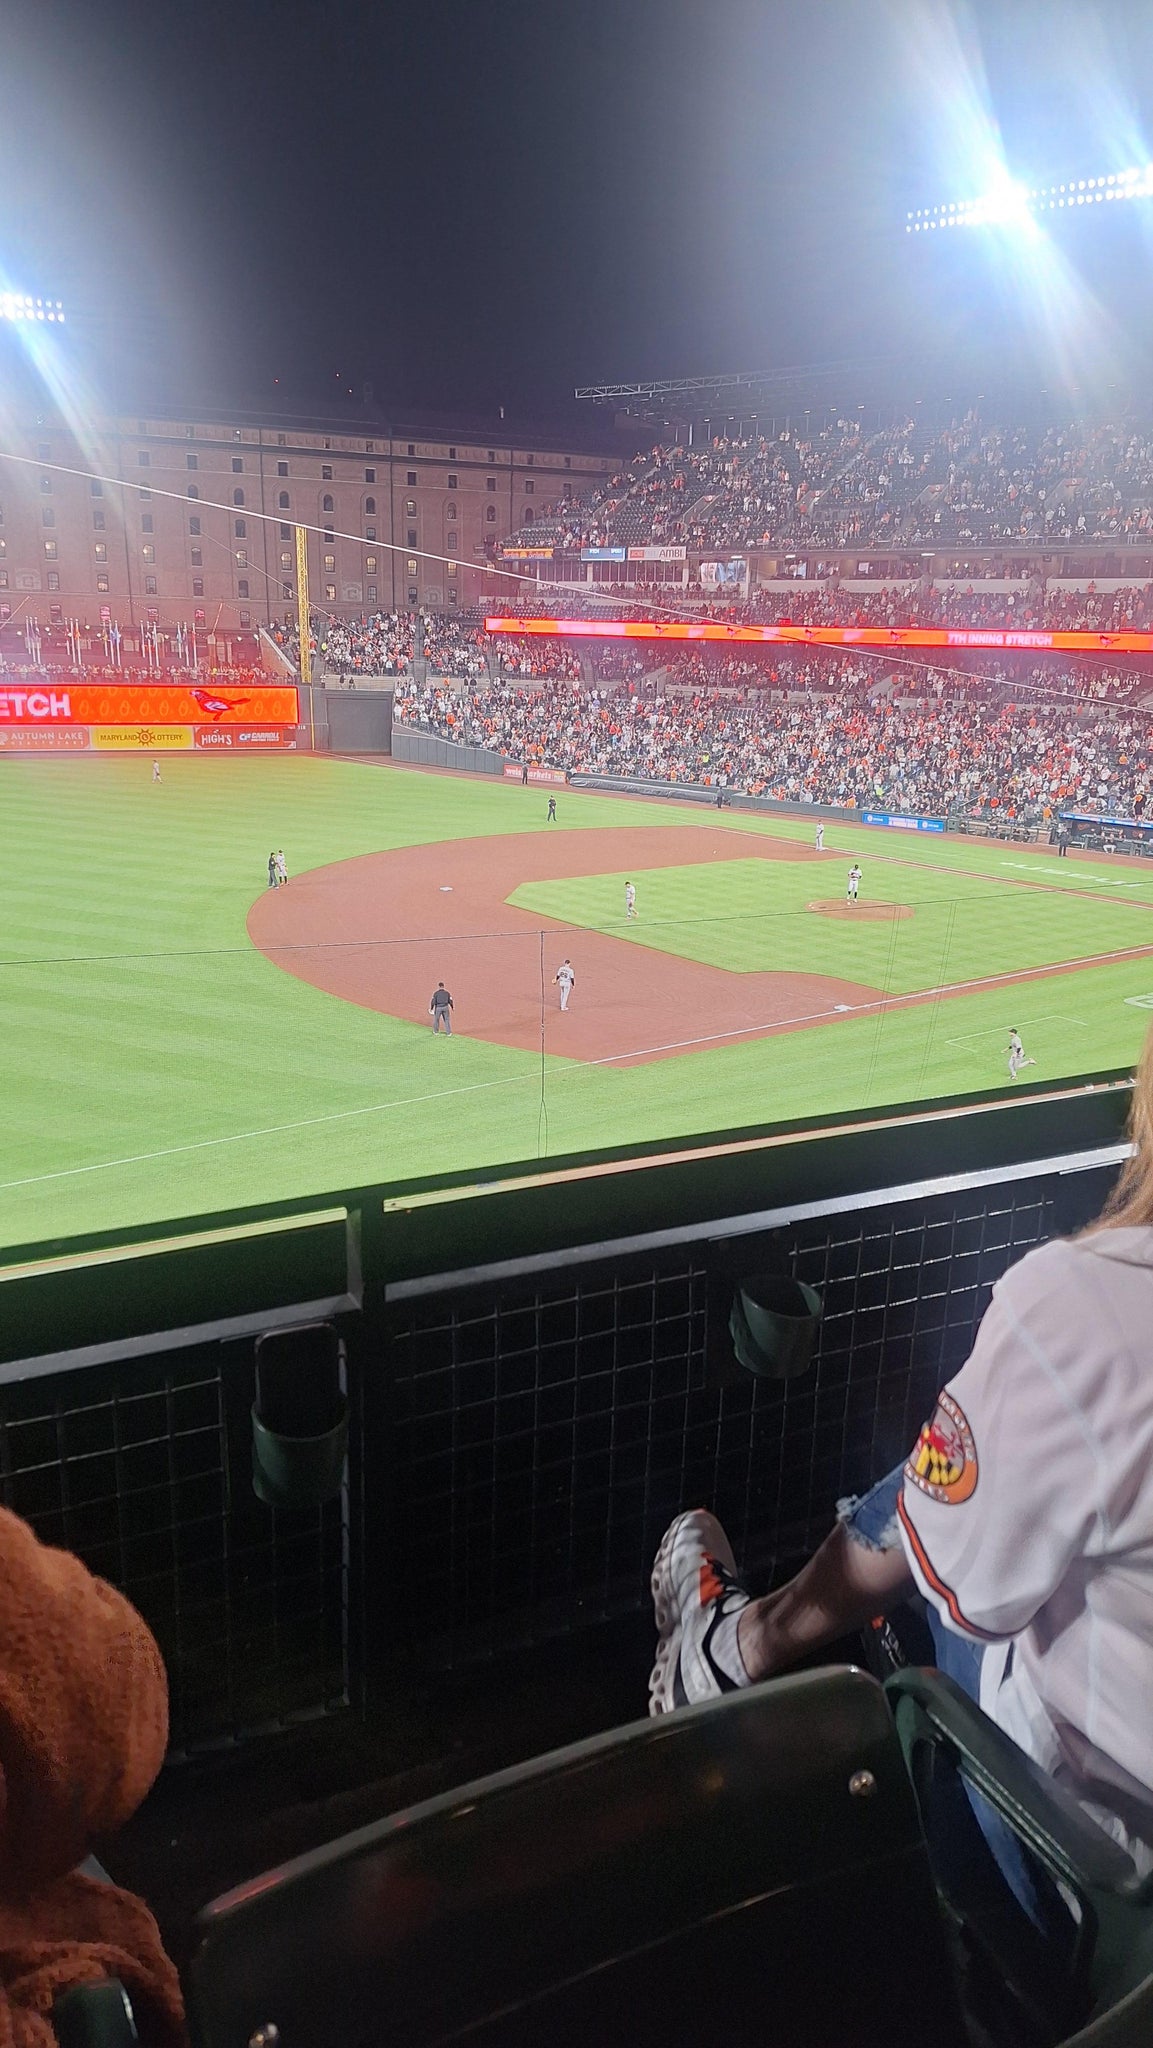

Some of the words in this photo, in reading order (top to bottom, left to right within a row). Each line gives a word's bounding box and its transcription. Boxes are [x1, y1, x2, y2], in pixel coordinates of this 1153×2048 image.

[968, 634, 1003, 644] INNING
[1005, 635, 1052, 645] STRETCH
[11, 732, 55, 740] AUTUMN
[58, 732, 83, 740] LAKE
[201, 734, 232, 746] HIGH'S
